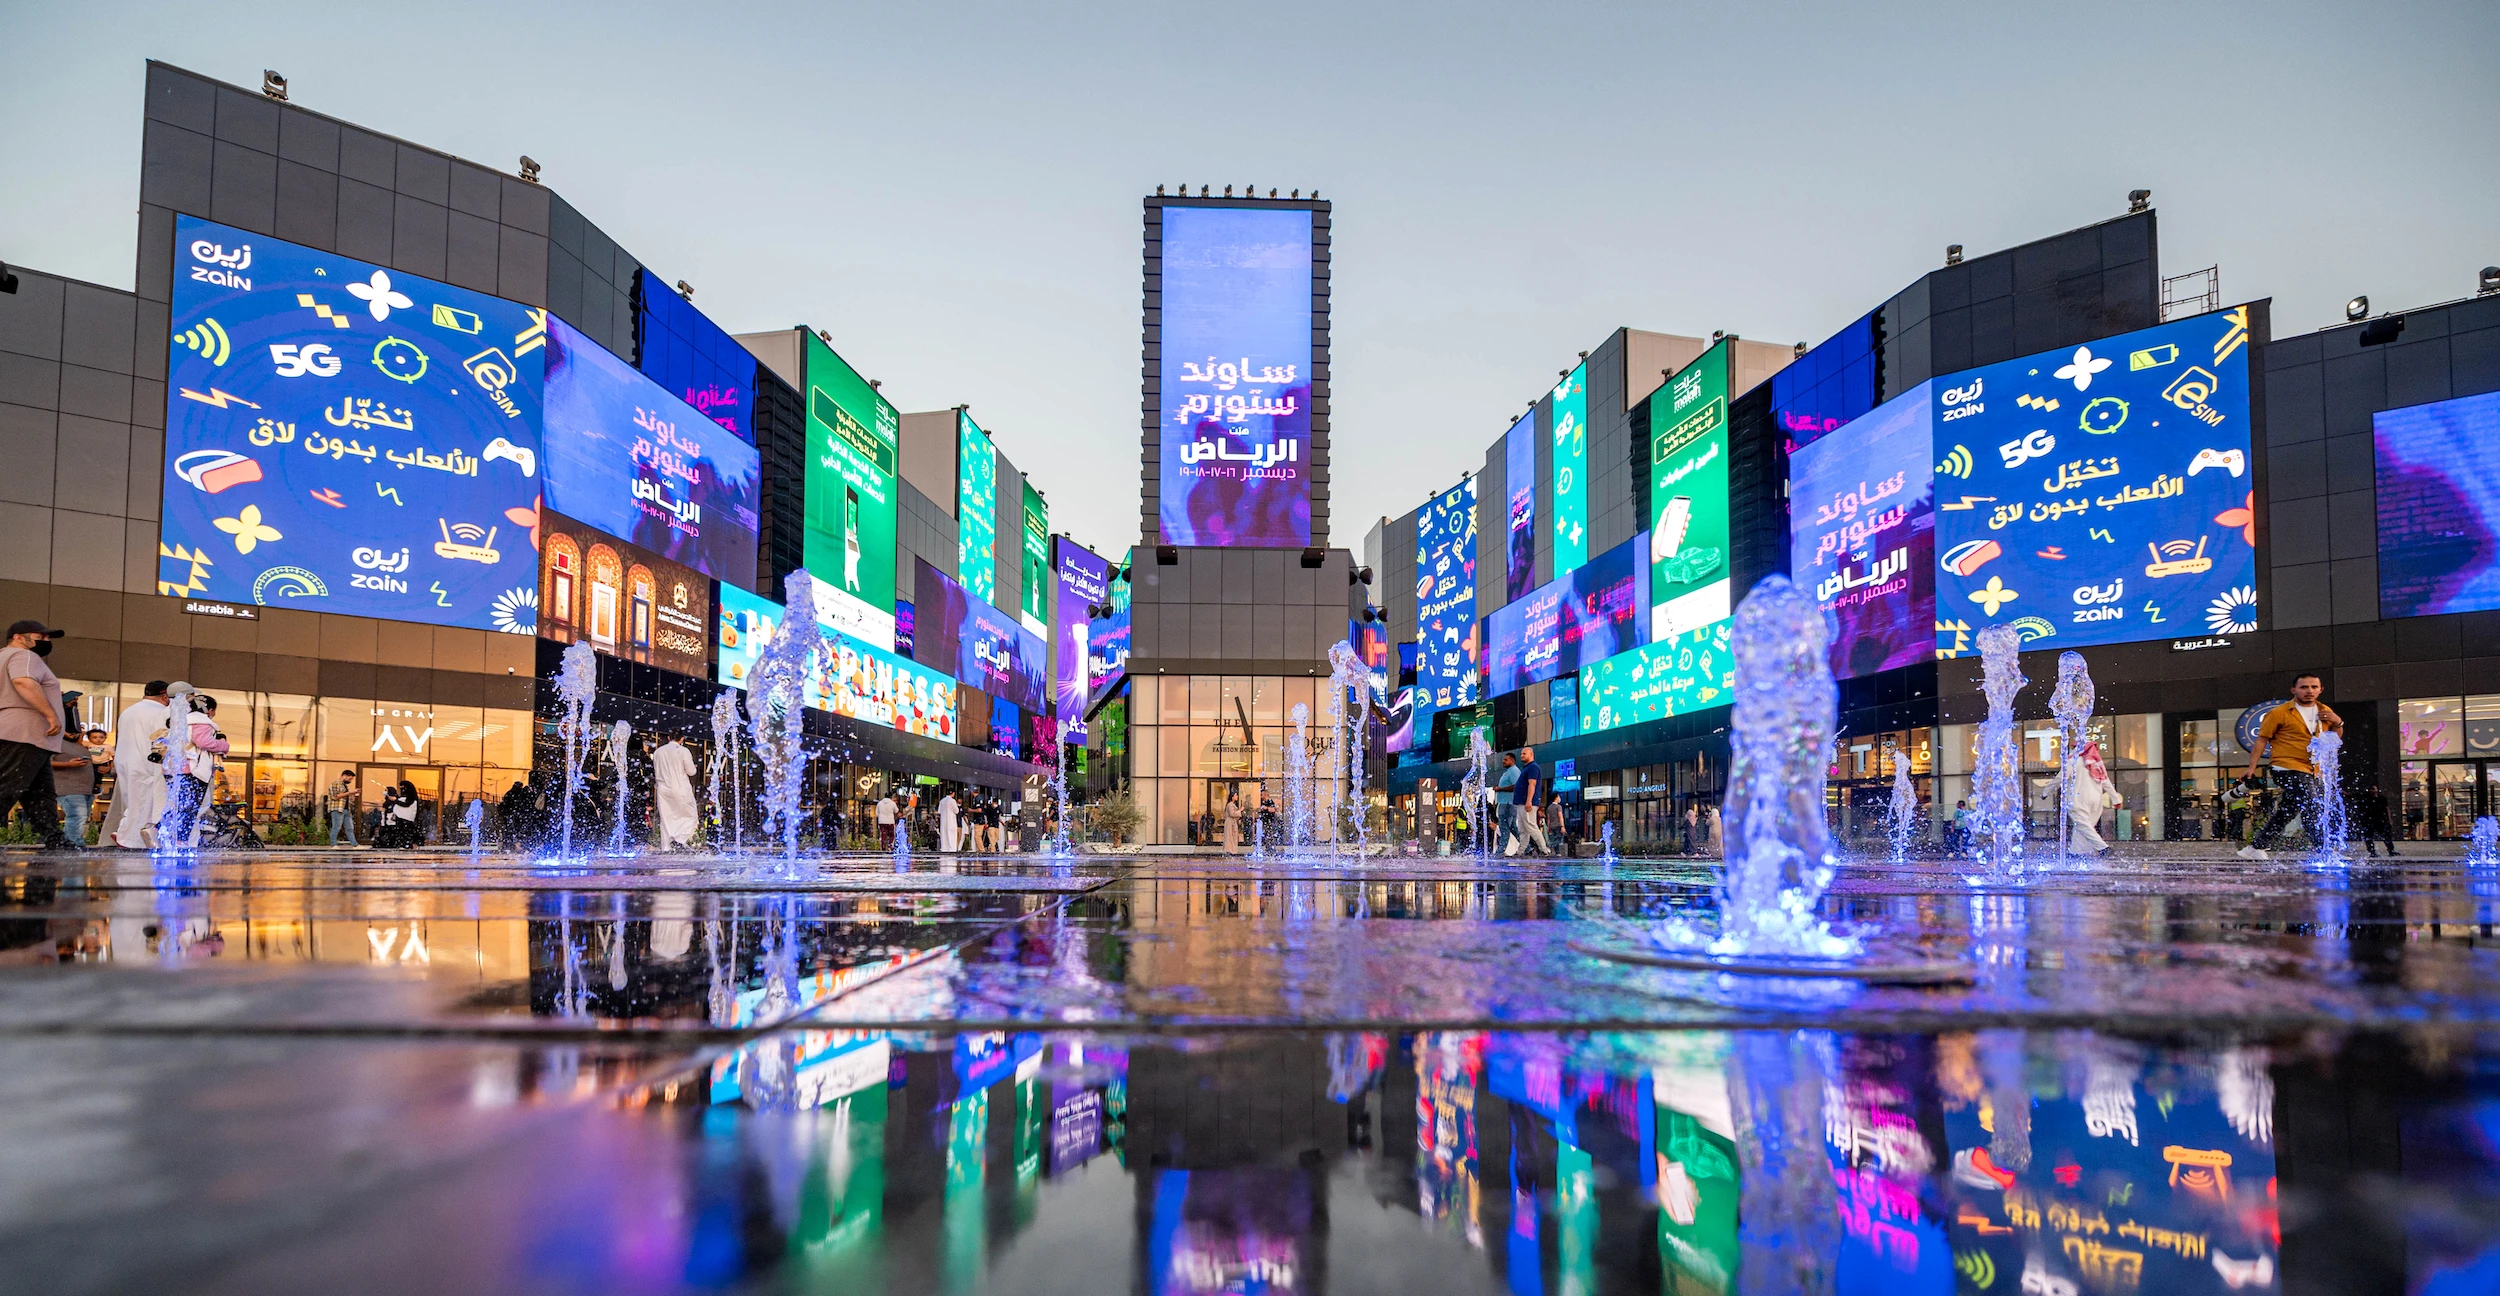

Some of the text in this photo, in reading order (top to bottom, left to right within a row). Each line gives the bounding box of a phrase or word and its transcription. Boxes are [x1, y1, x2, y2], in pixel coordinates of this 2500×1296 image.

[191, 240, 252, 269] زين
[269, 343, 342, 378] 5G
[1180, 355, 1298, 391] ساوند
[1174, 389, 1298, 424] ستورم
[1941, 377, 1983, 406] زين
[1555, 411, 1574, 446] 5G
[248, 417, 478, 477] الألعاب بدون لاق
[1180, 437, 1297, 468] الرياض
[1998, 429, 2056, 469] 5G
[1240, 466, 1296, 482] ديسمبر
[632, 477, 700, 524] الرياض
[1816, 471, 1906, 526] ساوند
[1988, 474, 2184, 530] الألعاب بدون لاق
[1813, 504, 1907, 566] ستورم
[352, 547, 410, 573] زين
[1436, 555, 1450, 576] 5G
[1816, 547, 1908, 601] الرياض
[1861, 578, 1907, 605] ديسمبر
[2072, 578, 2124, 606] زين
[186, 602, 234, 616] alarabia
[1420, 606, 1431, 622] لاق
[1431, 599, 1448, 617] بدون
[974, 638, 1010, 672] الرياض
[1525, 637, 1559, 665] الرياض
[2173, 638, 2213, 650] العربية
[746, 609, 945, 717] HPPINESS
[370, 708, 385, 716] LE
[839, 690, 893, 723] FOREVER
[1213, 719, 1241, 727] THE
